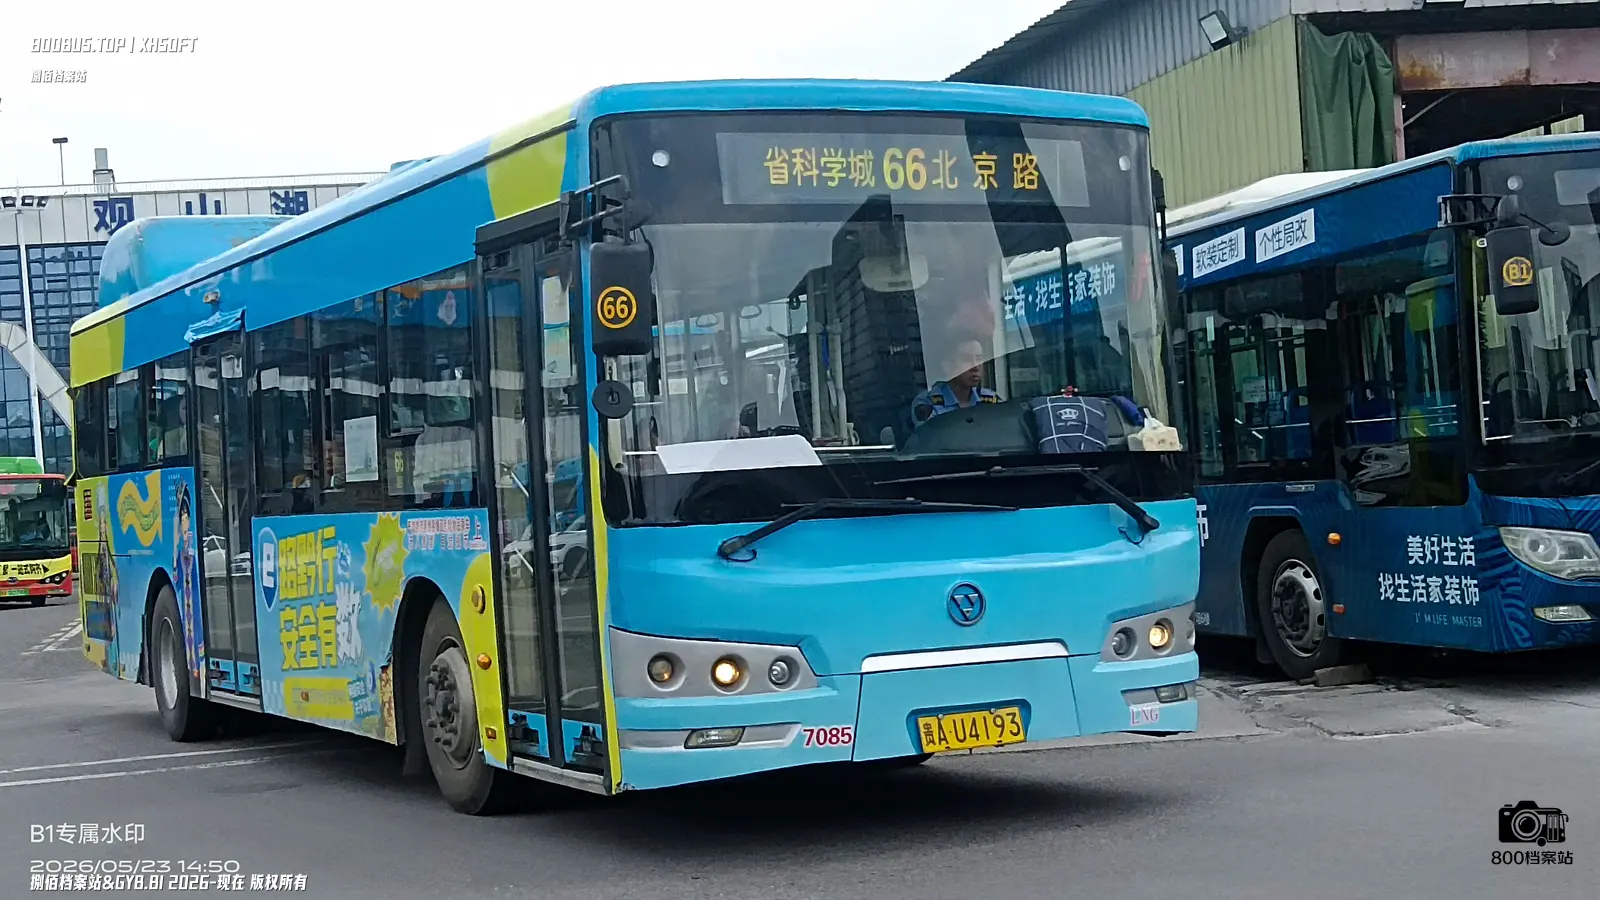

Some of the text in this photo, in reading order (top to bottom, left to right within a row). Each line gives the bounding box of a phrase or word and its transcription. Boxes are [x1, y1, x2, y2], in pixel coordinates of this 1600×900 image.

[764, 146, 875, 187] 省科学城
[883, 147, 927, 190] 66
[1260, 216, 1308, 256] 个性局改
[1195, 233, 1239, 271] 软装定制
[1509, 263, 1529, 280] B1
[603, 296, 629, 319] 66
[1407, 535, 1476, 566] 美好生活
[1379, 572, 1480, 606] 找生活家装饰
[1452, 616, 1483, 628] MASTER
[1131, 707, 1159, 725] LNG
[803, 726, 853, 747] 7085
